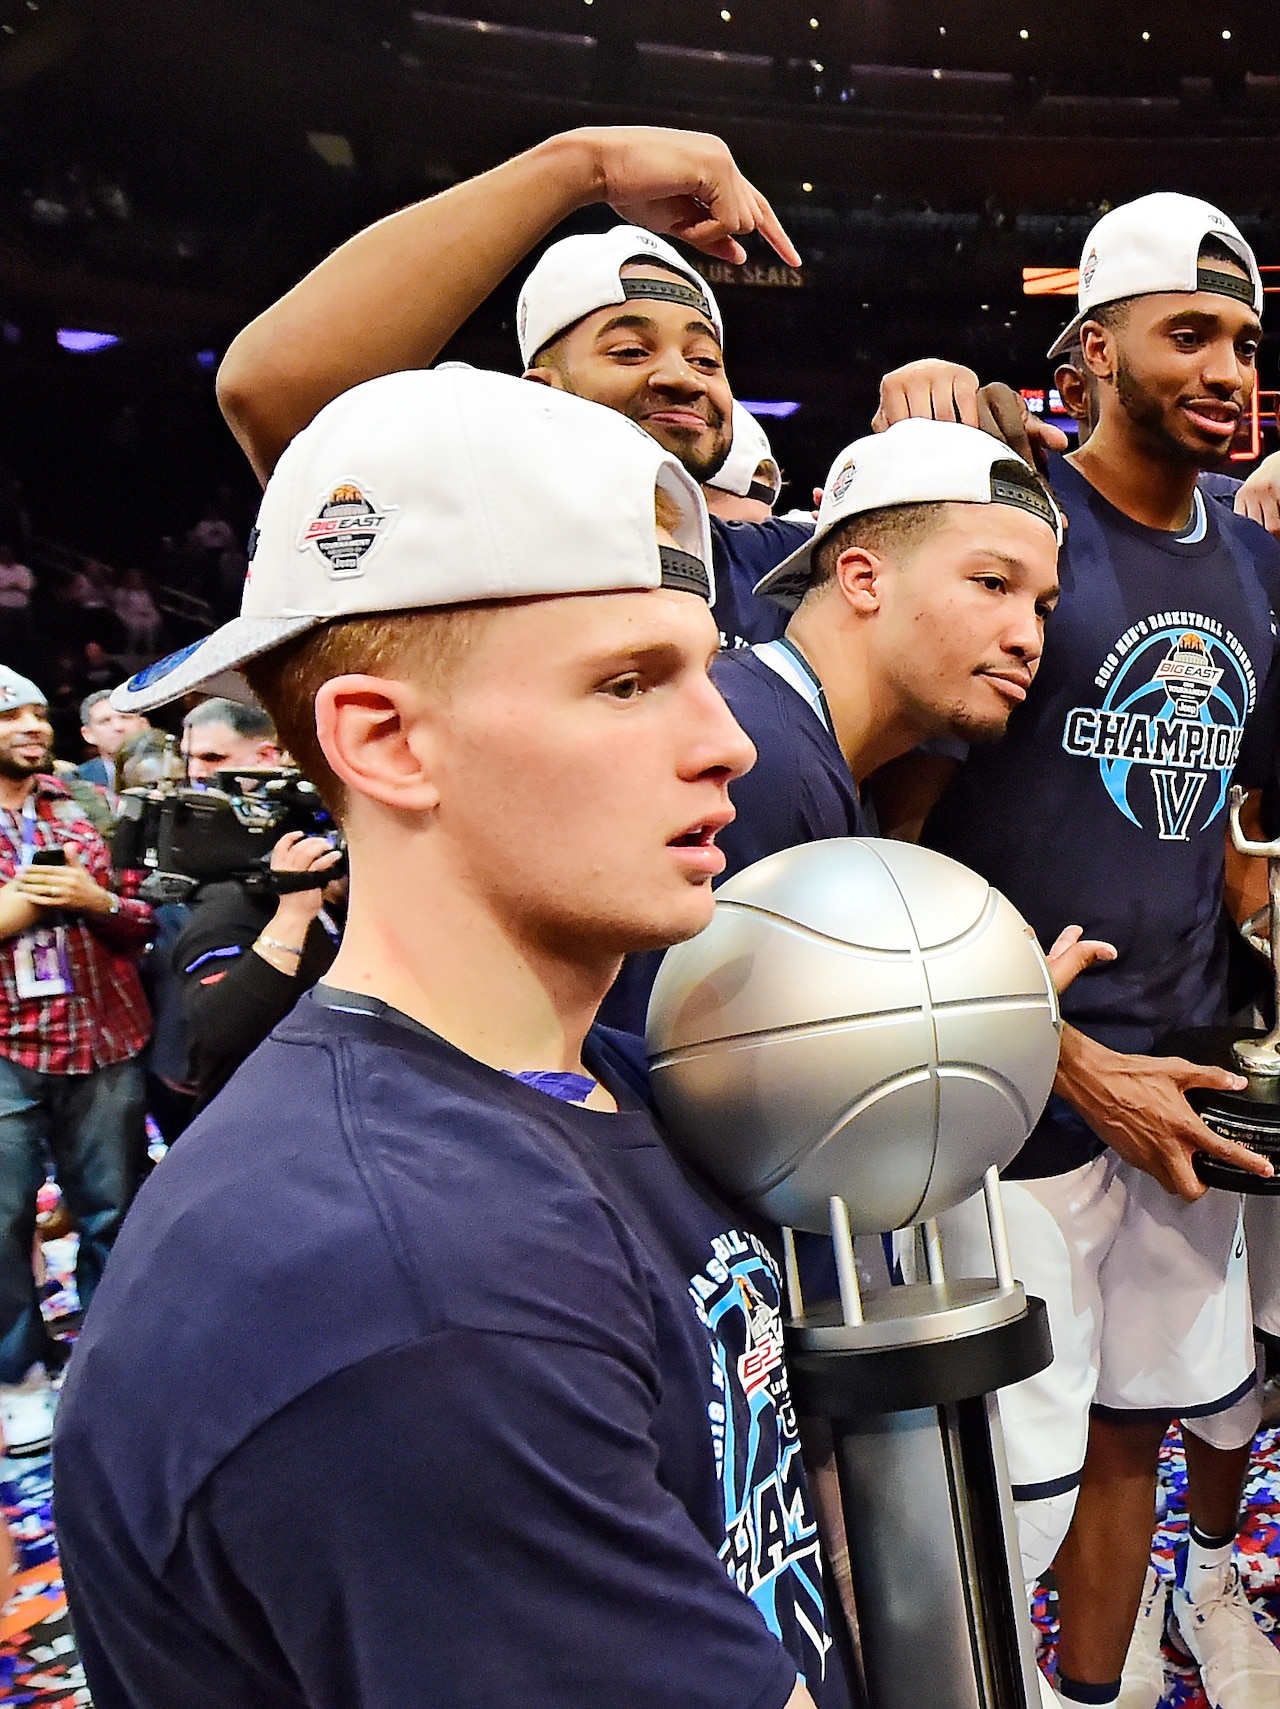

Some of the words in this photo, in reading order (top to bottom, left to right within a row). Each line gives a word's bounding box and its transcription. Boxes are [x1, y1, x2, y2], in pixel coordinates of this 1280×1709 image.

[308, 520, 338, 532] BIG
[338, 516, 386, 529] EAST
[1148, 611, 1223, 637] BASKETBALL
[1160, 663, 1185, 674] BIG
[1184, 667, 1219, 680] EAST
[1151, 768, 1207, 839] V
